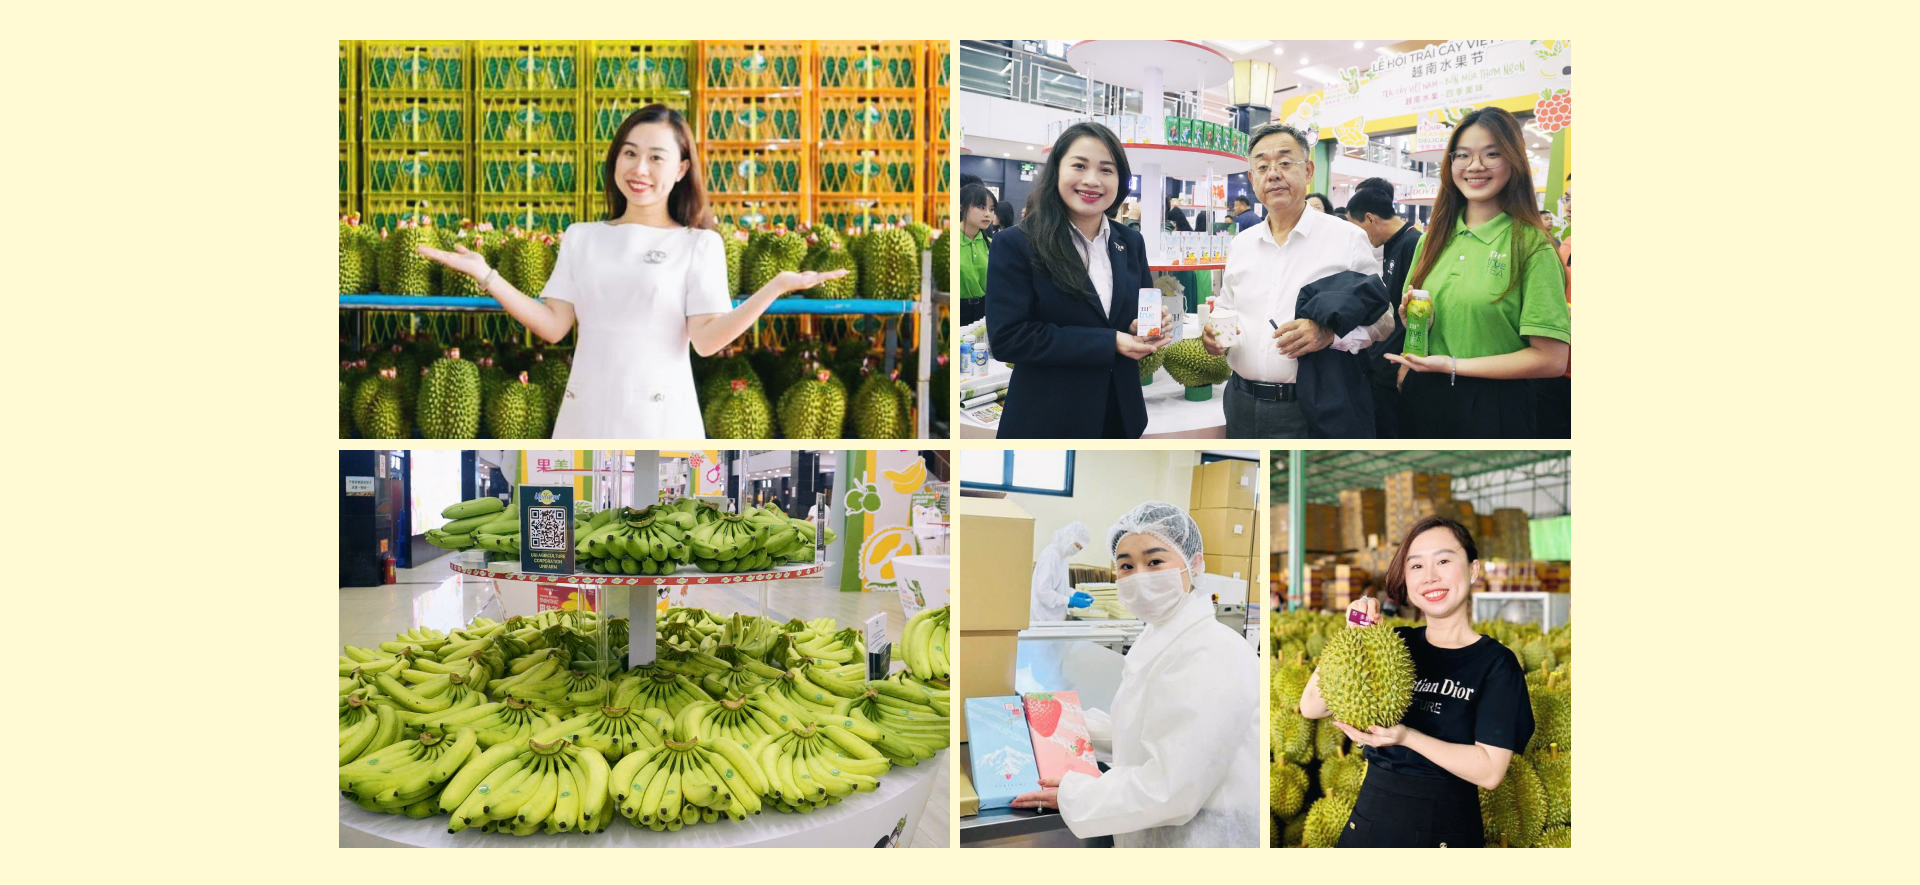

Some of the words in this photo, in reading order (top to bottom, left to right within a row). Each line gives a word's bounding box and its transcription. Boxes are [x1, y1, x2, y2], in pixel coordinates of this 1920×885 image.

[1387, 54, 1407, 69] HỘI
[1410, 46, 1435, 64] TRÁI
[1438, 40, 1464, 56] CÂY
[1411, 50, 1484, 78] 越南水果节
[1419, 121, 1441, 132] FOUR
[1490, 250, 1501, 260] TH
[1487, 258, 1506, 271] true
[1440, 678, 1475, 700] Dior
